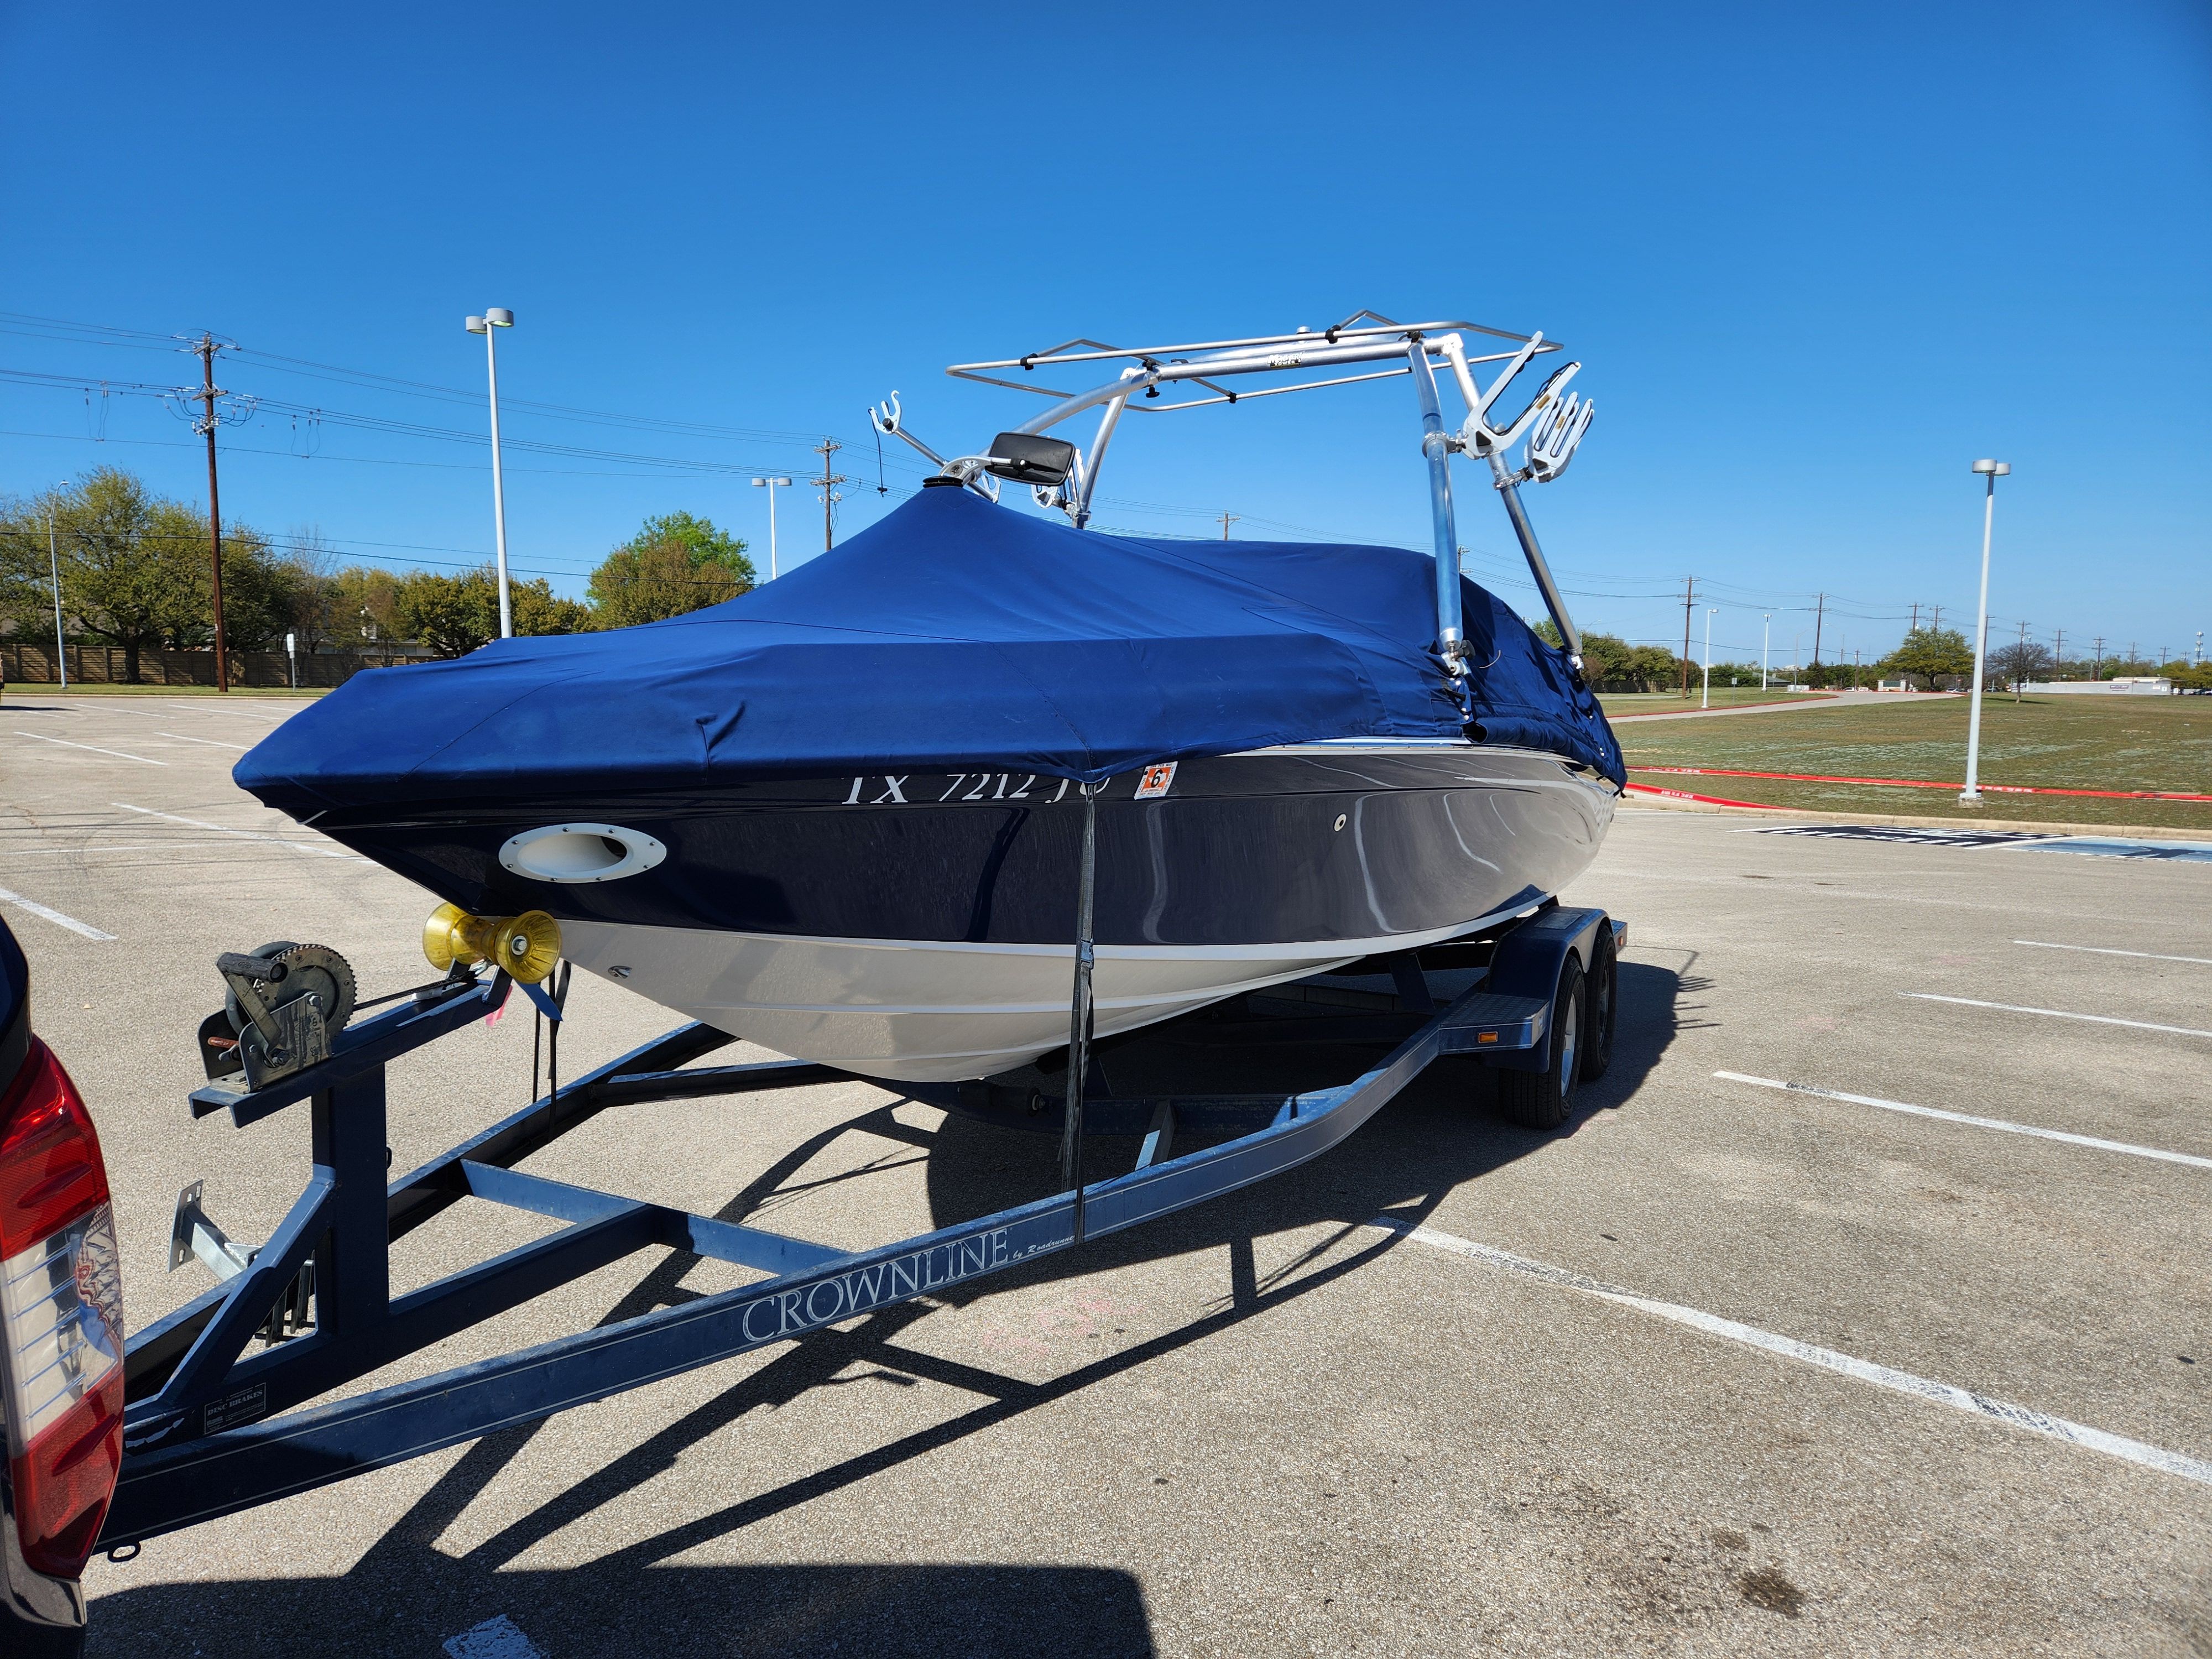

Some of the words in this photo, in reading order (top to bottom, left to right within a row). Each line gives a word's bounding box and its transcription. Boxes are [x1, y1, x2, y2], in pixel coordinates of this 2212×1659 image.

[842, 775, 909, 804] TX
[938, 774, 1036, 802] 7212
[1151, 769, 1163, 787] 6
[742, 1228, 1009, 1342] CROWNLINE
[1013, 1250, 1023, 1260] by
[1027, 1235, 1075, 1255] Roadrunne
[207, 1403, 228, 1416] DISC
[229, 1390, 263, 1407] BRAKES
